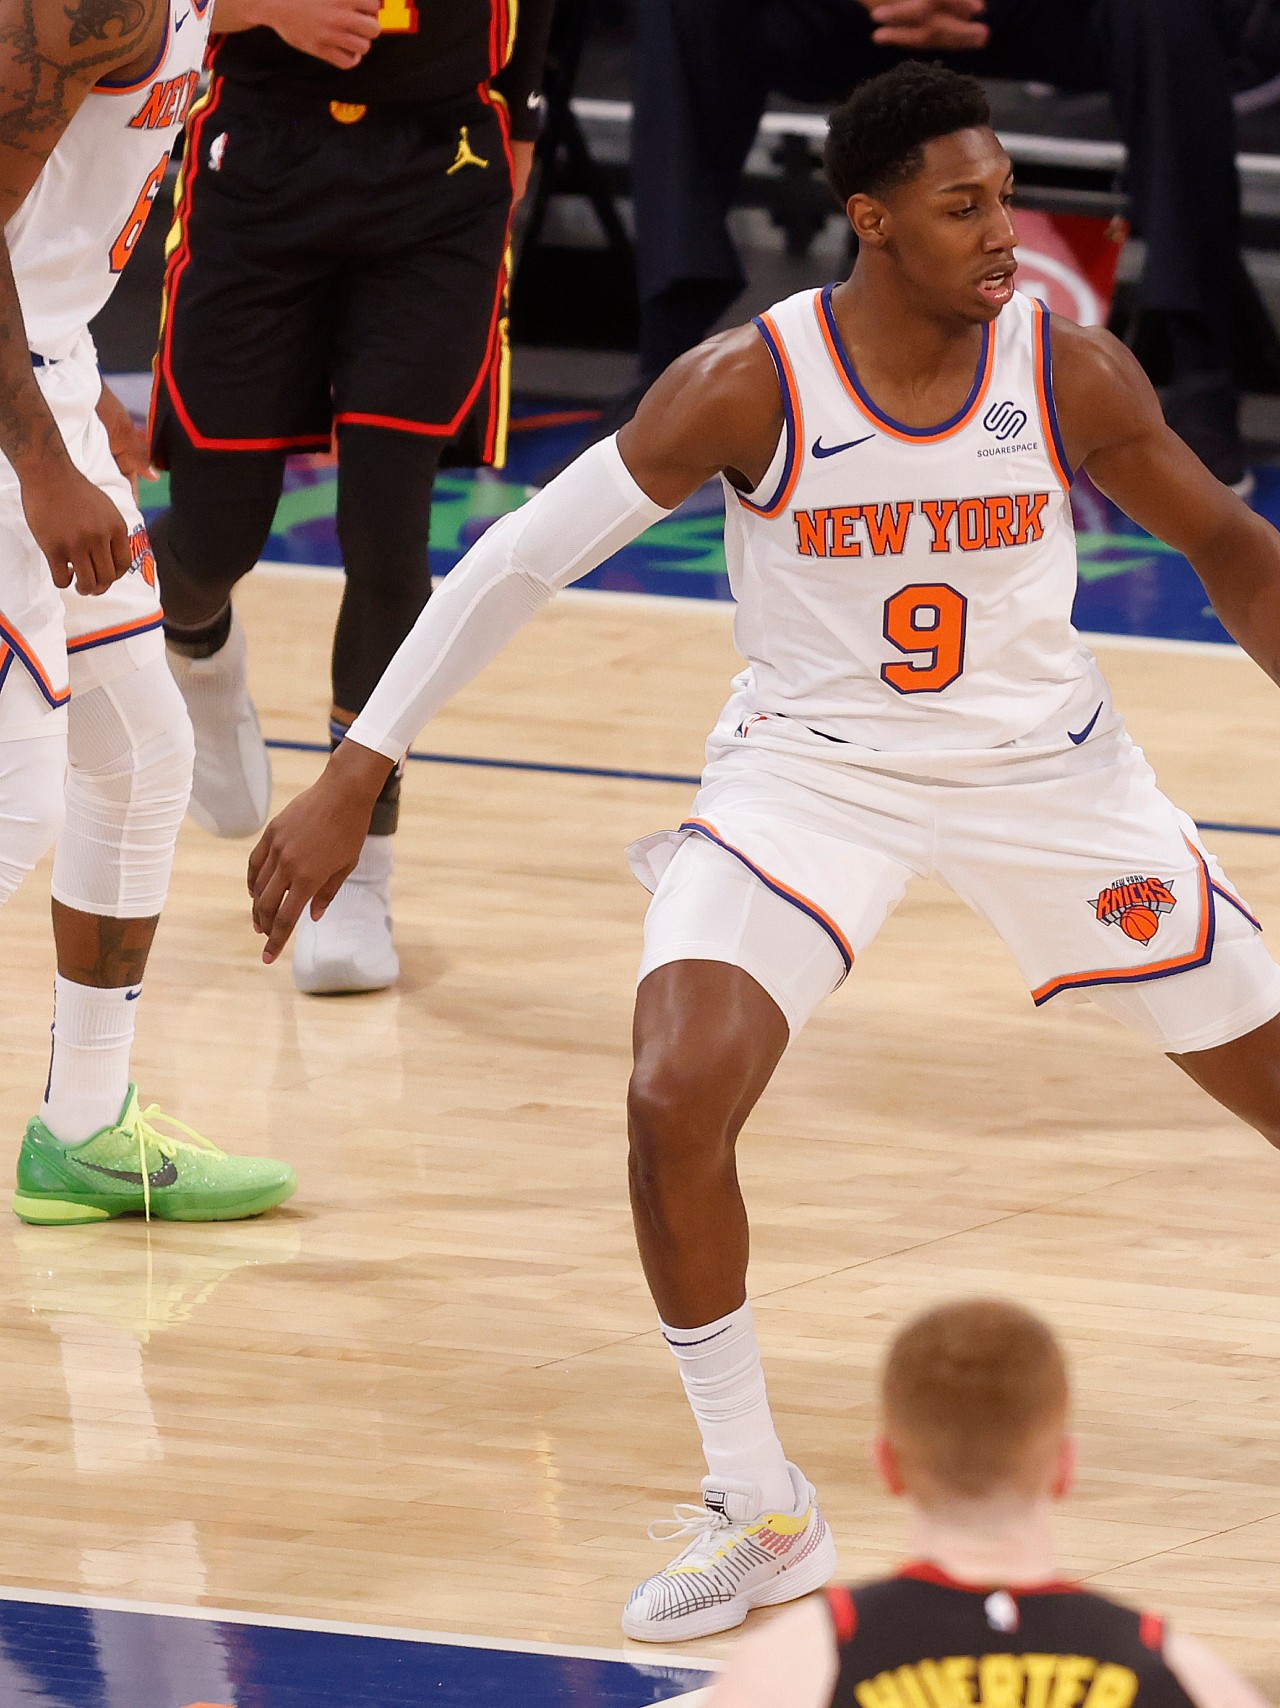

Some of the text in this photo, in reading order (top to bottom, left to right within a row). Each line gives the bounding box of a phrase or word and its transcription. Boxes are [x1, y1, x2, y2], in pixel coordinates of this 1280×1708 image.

[977, 442, 1038, 458] SQUARESPACE
[792, 492, 1050, 559] NEW YORK
[880, 582, 968, 695] 9
[1095, 877, 1178, 922] KNICKS
